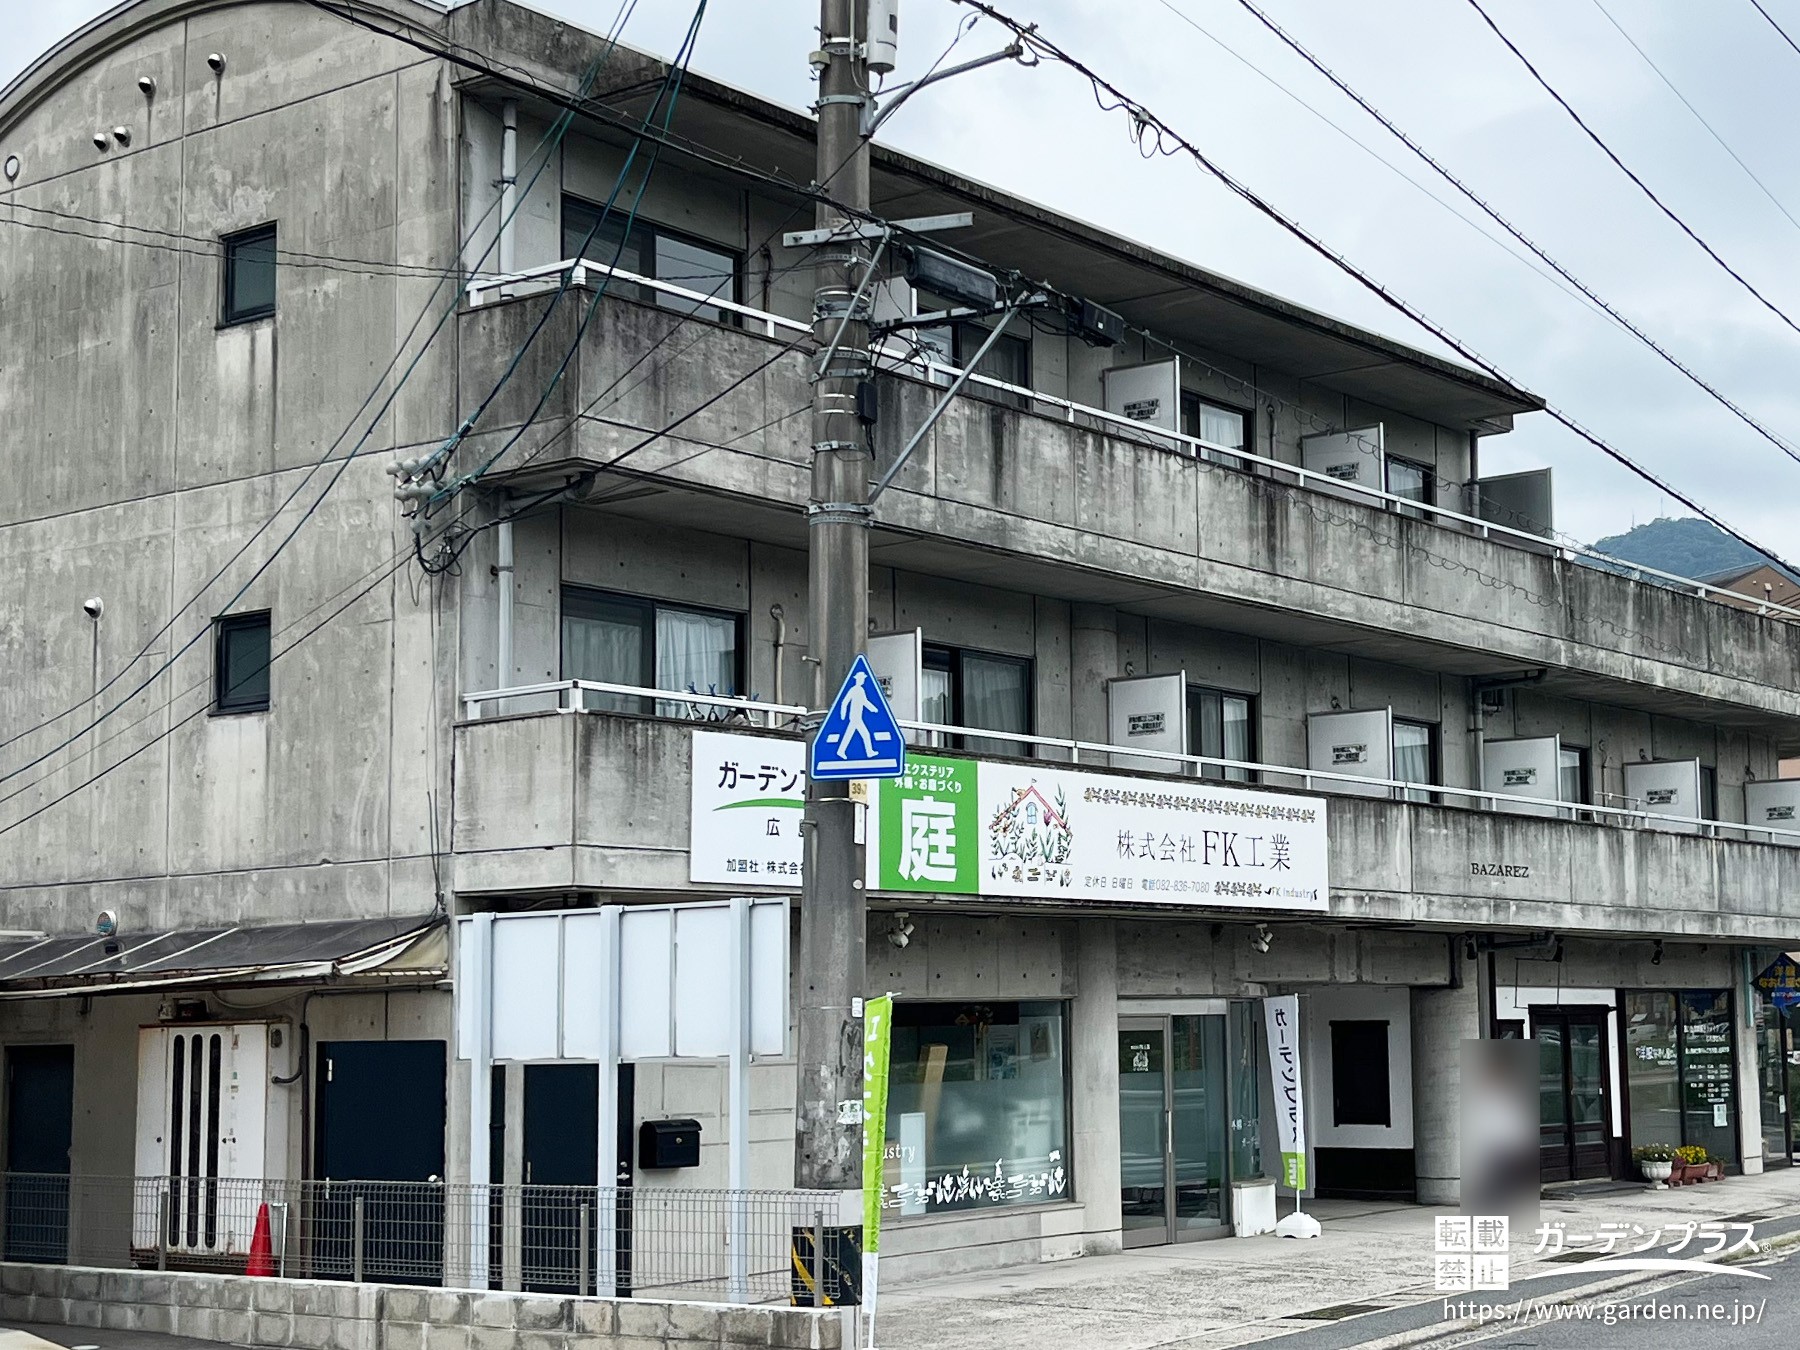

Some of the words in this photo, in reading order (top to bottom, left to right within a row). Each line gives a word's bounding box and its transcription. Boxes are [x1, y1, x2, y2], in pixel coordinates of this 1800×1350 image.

[718, 761, 805, 795] ガーデン
[904, 763, 954, 778] エクステリア
[898, 795, 957, 882] 庭
[726, 858, 804, 875] 加盟社：株式会
[1471, 862, 1529, 878] BAZAREZ
[1084, 876, 1107, 888] 定休日
[1112, 877, 1133, 889] 日曜日
